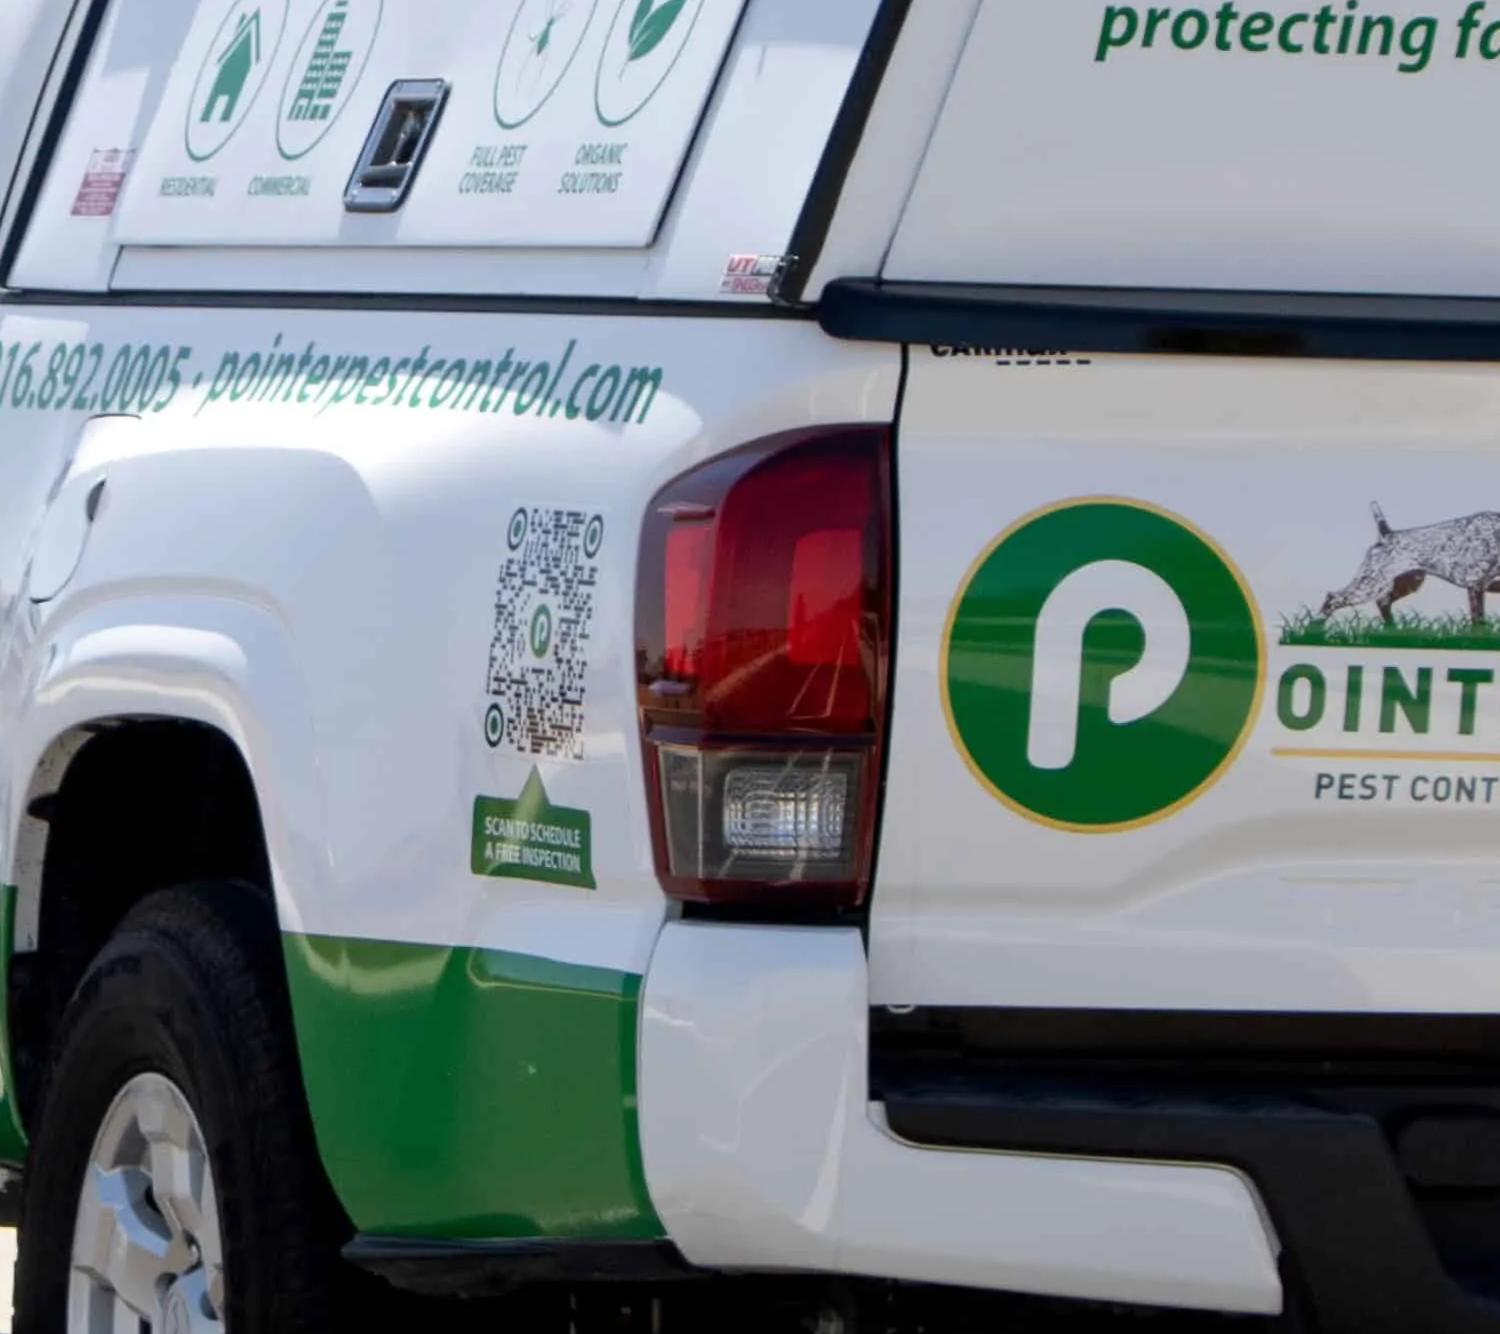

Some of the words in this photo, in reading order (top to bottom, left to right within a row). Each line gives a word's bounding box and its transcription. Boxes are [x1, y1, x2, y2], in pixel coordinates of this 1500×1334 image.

[500, 143, 528, 167] PEST
[575, 142, 627, 166] ORGANIC
[458, 170, 518, 194] COVERAGE
[557, 170, 622, 194] SOLUTIONS
[193, 331, 664, 424] pointerpestcontrol.com
[1026, 559, 1191, 770] P
[1314, 774, 1401, 801] PEST
[484, 815, 514, 838] SCAN
[513, 819, 530, 841] TO
[530, 822, 581, 848] SCHEDULE
[484, 842, 493, 860] A
[495, 843, 521, 864] FREE
[522, 847, 581, 873] INSPECTION
